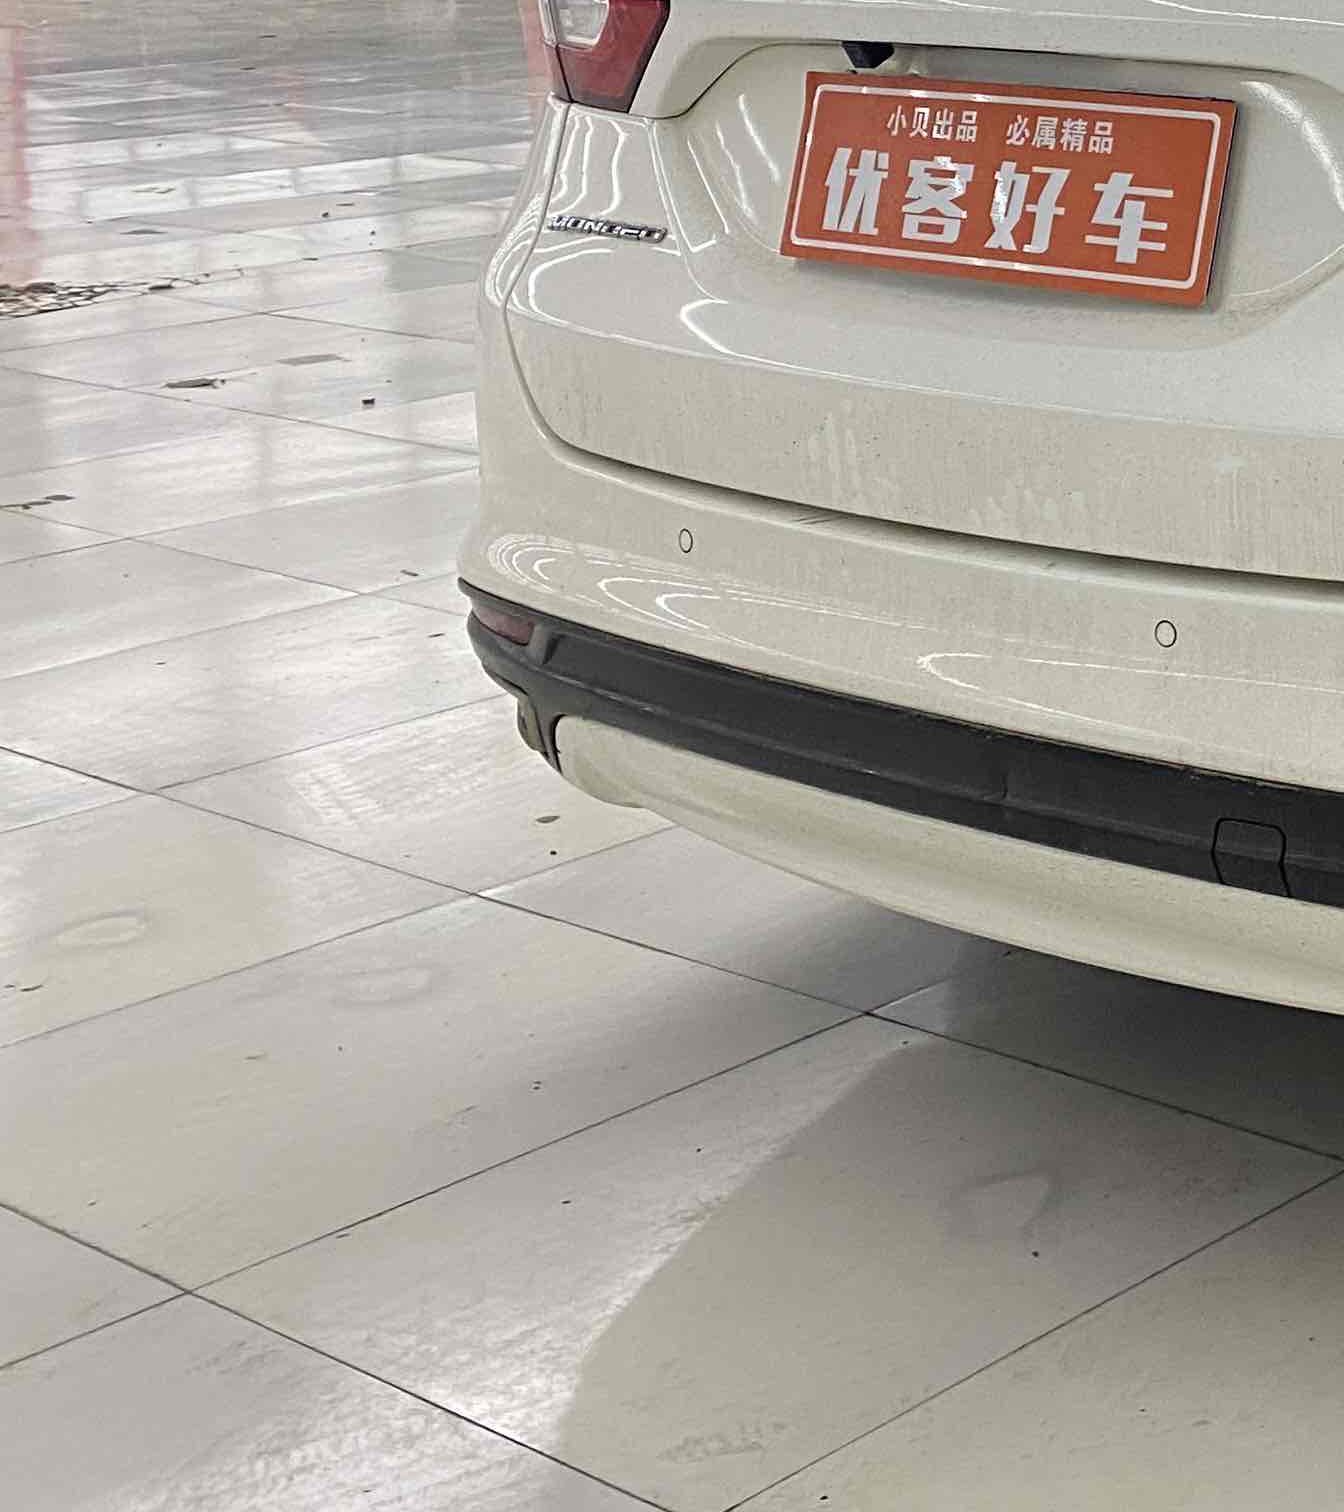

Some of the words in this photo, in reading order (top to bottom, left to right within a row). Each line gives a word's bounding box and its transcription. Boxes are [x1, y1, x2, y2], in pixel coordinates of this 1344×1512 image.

[886, 104, 978, 143] 小贝出品
[1005, 114, 1114, 155] 必属精品
[824, 147, 1175, 265] 优客好车
